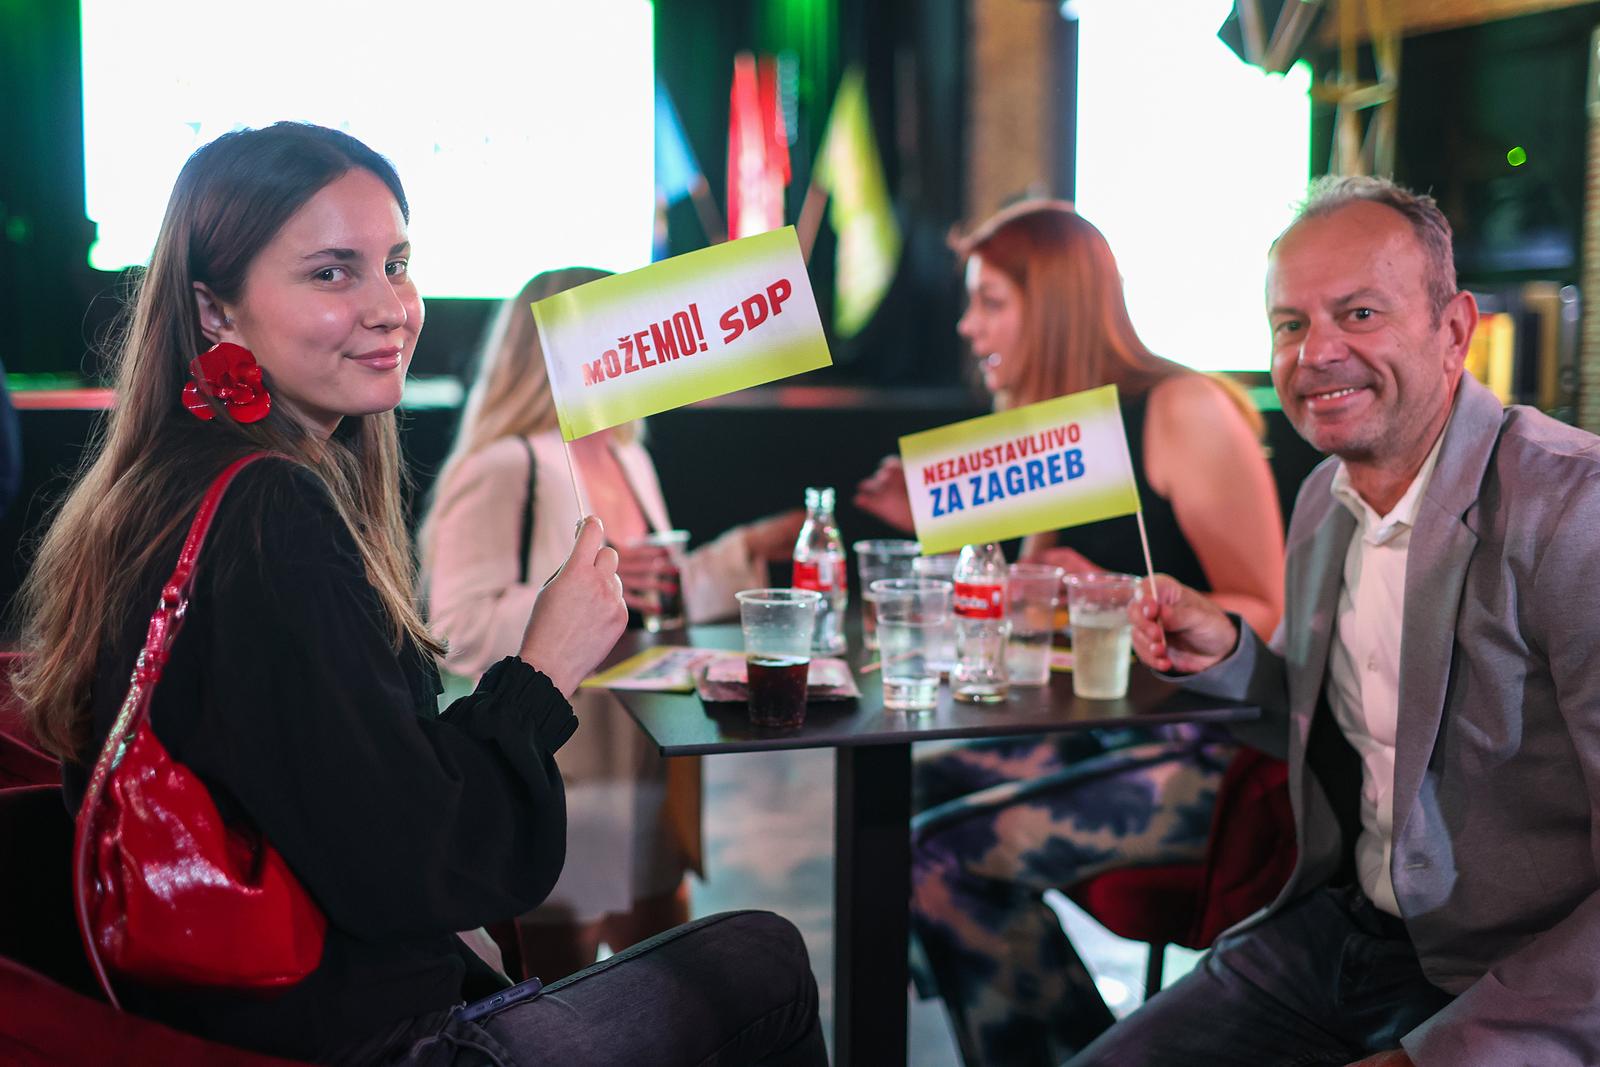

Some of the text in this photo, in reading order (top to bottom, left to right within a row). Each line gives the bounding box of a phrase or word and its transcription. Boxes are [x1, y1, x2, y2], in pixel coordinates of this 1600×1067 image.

[582, 278, 792, 386] MOŽEMO! SDP
[923, 422, 1081, 485] NEZAUSTAVLJIVO
[930, 448, 1085, 517] ZA ZAGREB
